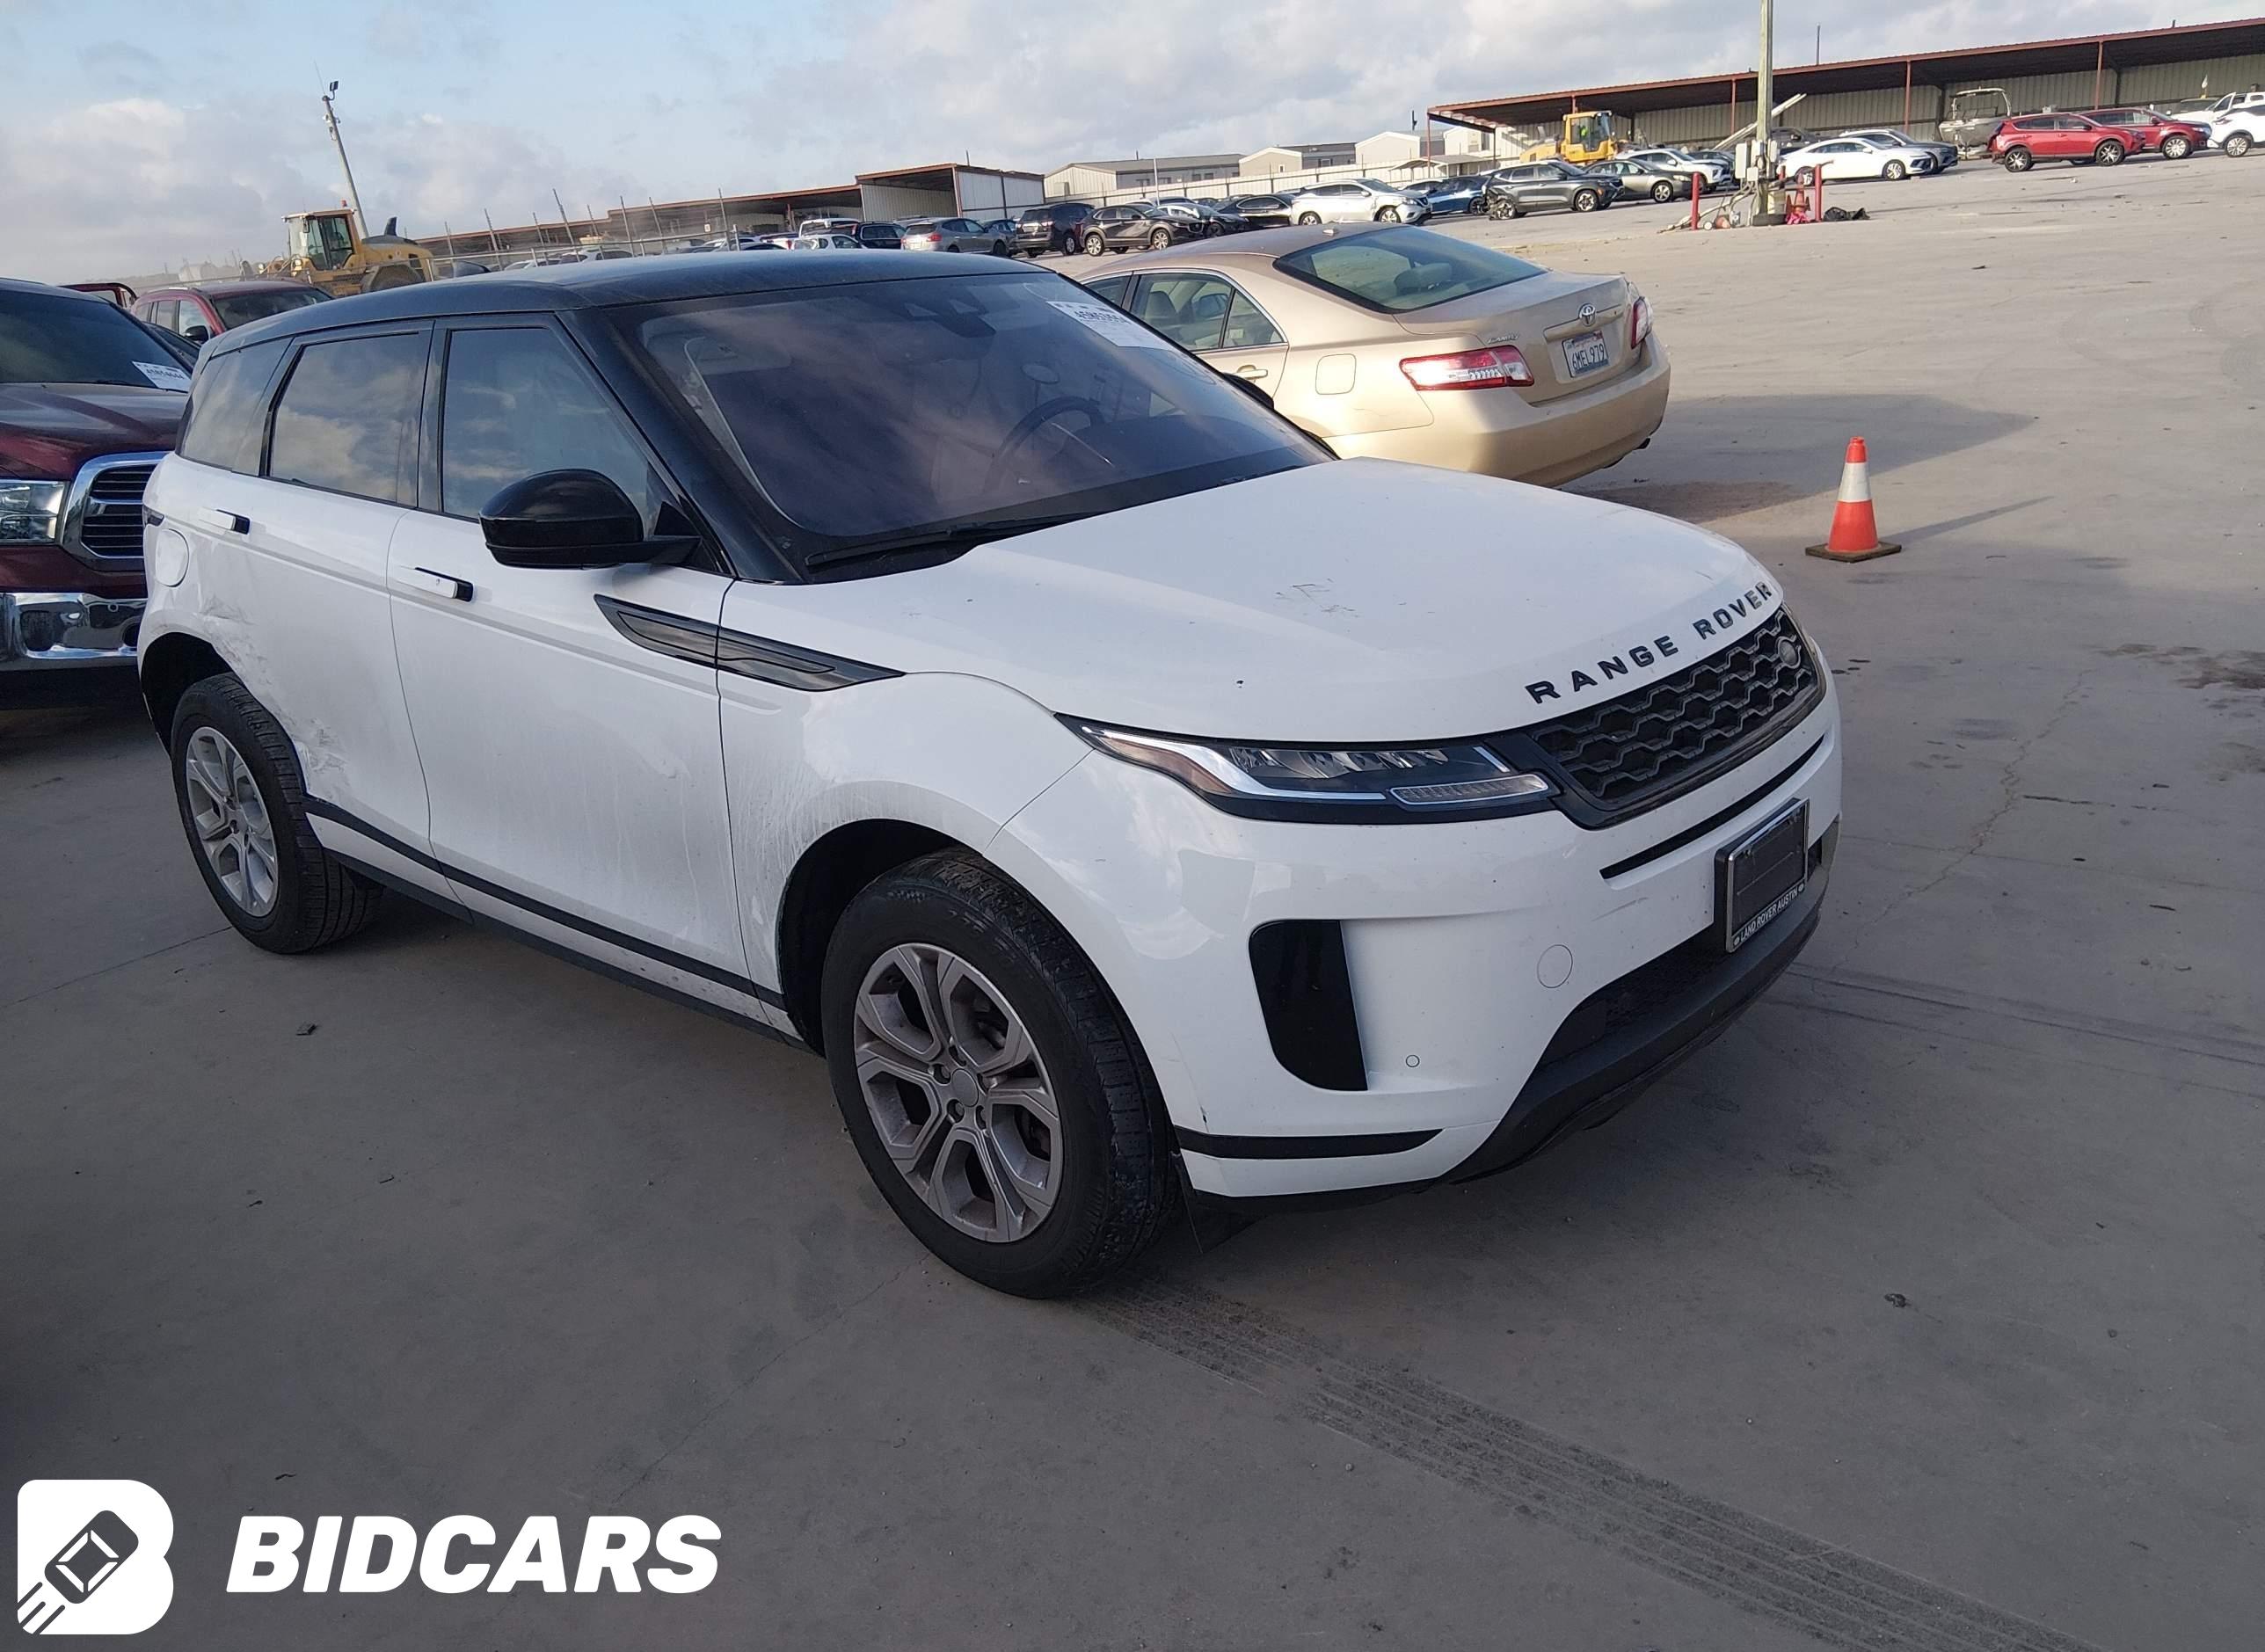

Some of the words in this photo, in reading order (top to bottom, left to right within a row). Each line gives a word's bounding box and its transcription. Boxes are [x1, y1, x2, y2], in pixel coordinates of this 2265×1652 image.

[1525, 635, 1679, 704] RANGE
[1693, 581, 1773, 640] ROVER
[1740, 920, 1757, 942] LAND
[1757, 903, 1777, 928] ROVER
[1777, 885, 1798, 913] AUSTIN
